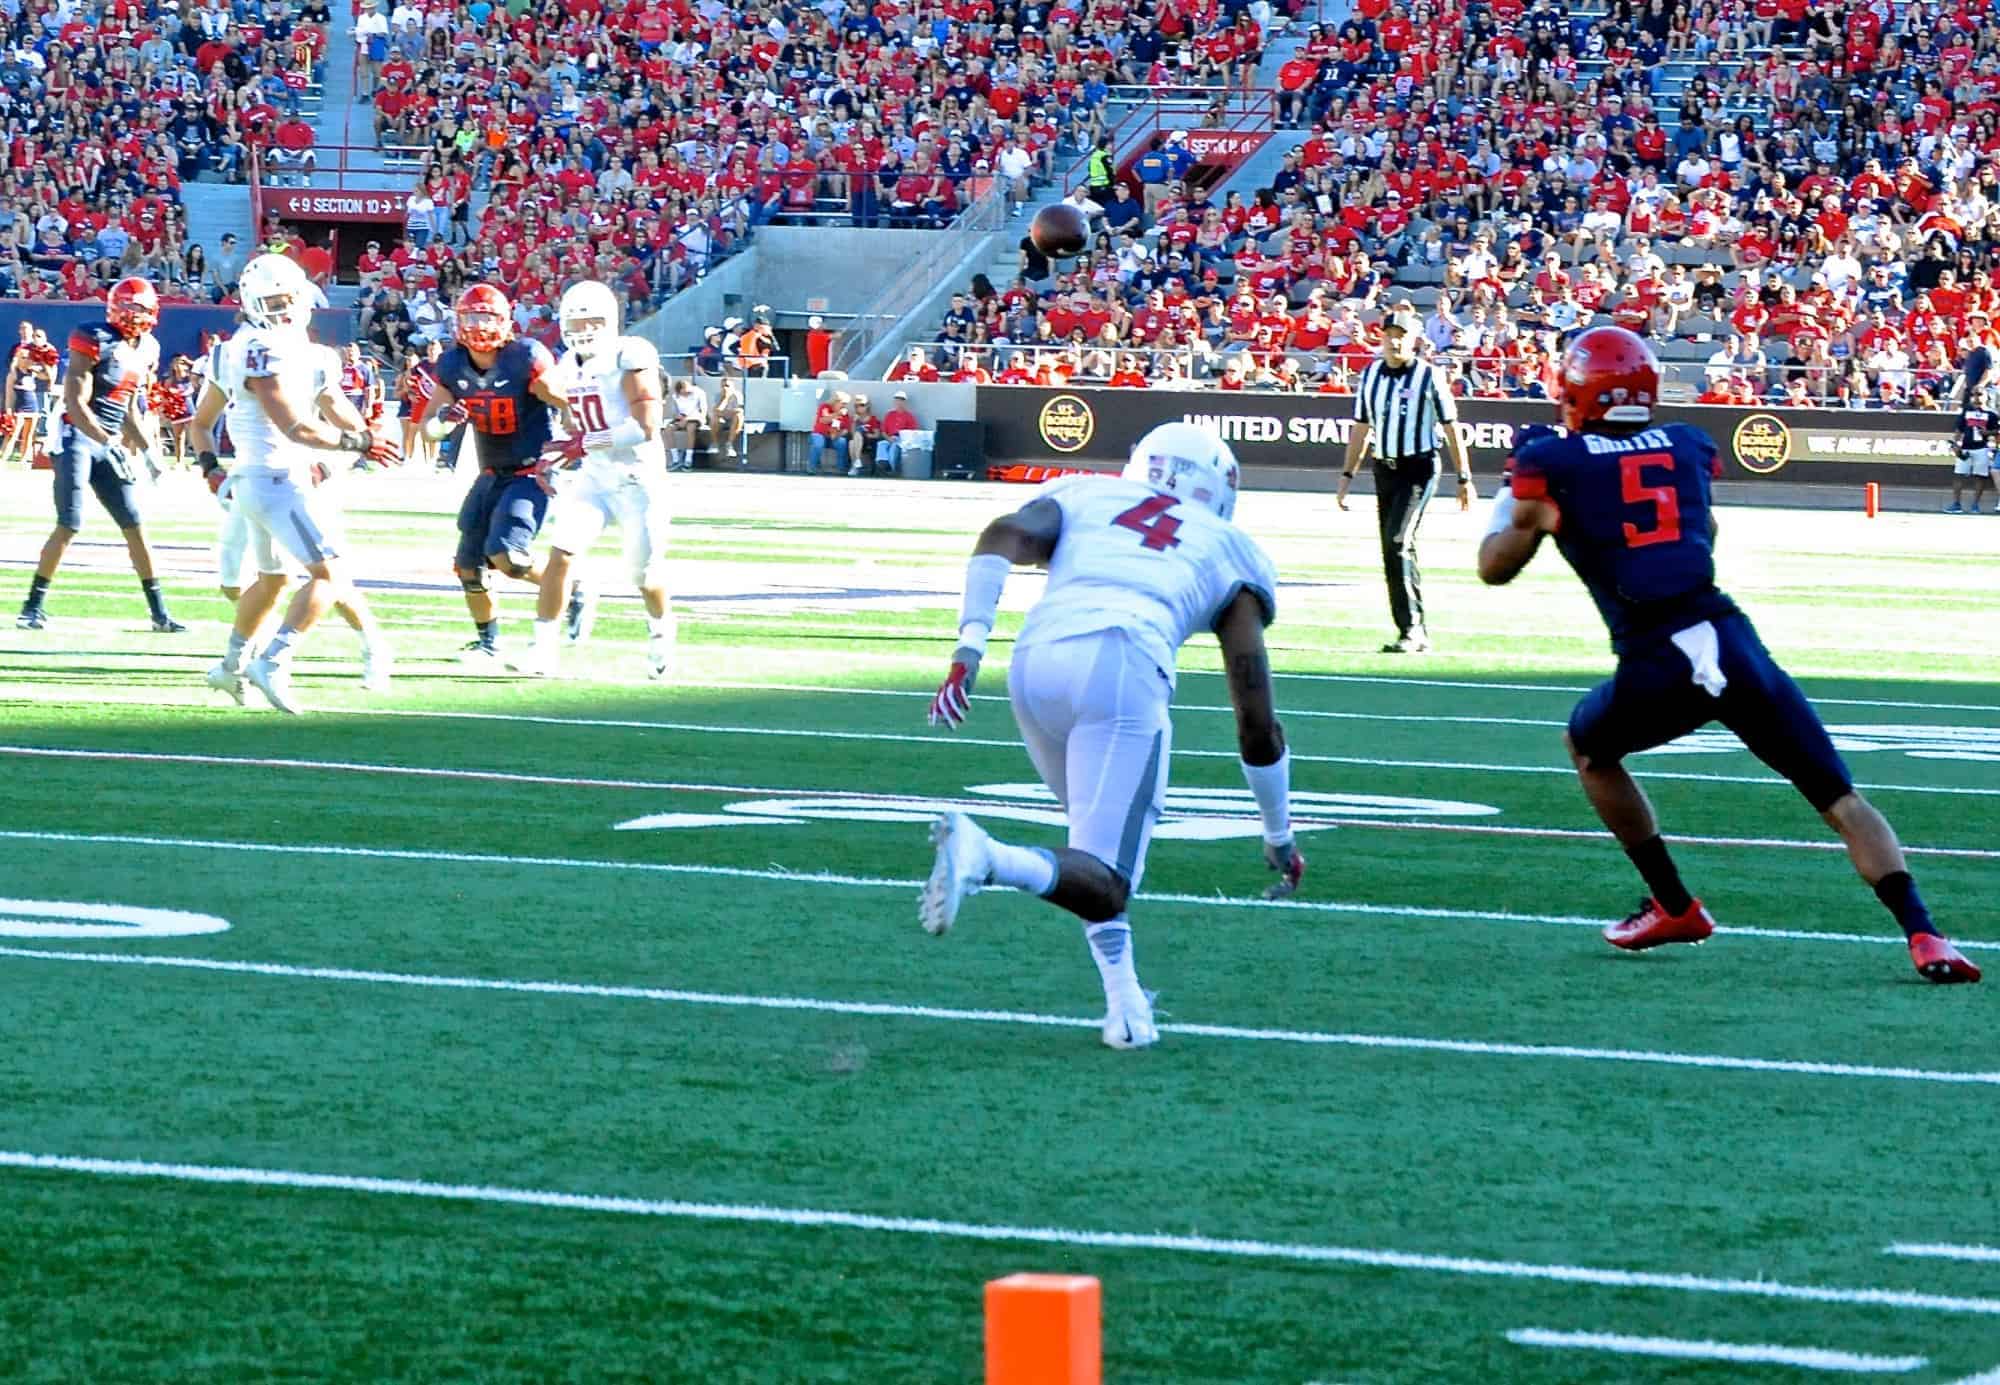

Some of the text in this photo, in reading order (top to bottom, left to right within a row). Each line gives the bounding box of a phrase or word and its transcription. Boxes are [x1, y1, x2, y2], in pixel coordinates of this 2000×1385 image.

[301, 197, 379, 214] 9 SECTION 10
[1807, 435, 1836, 454] WE
[1837, 436, 1872, 455] ARE
[1619, 452, 1681, 549] 5
[1110, 494, 1184, 552] 4
